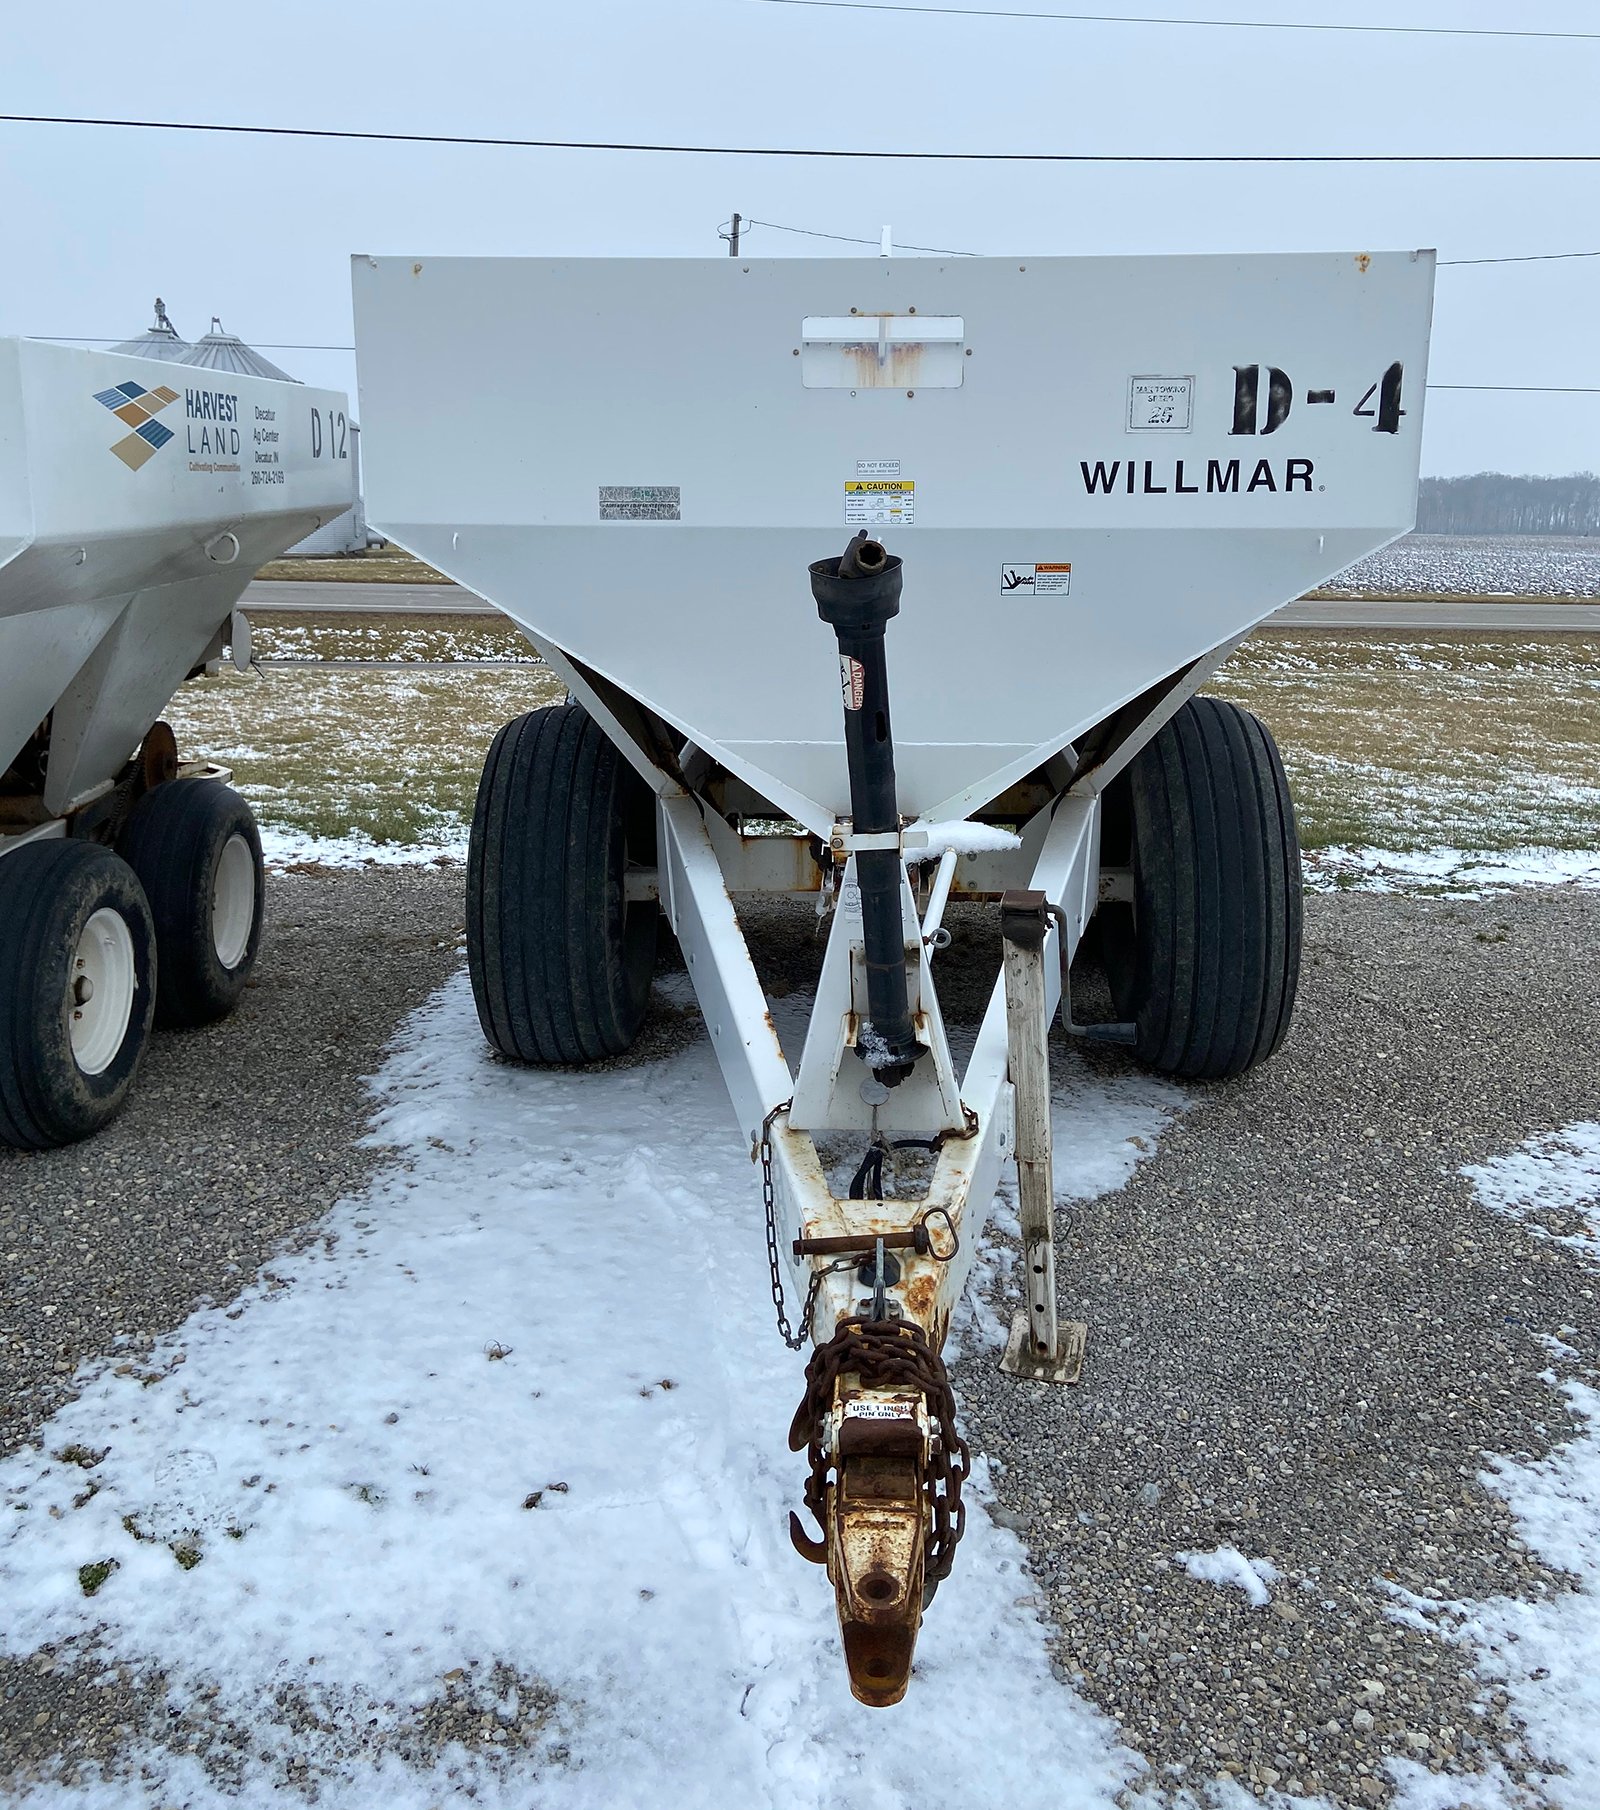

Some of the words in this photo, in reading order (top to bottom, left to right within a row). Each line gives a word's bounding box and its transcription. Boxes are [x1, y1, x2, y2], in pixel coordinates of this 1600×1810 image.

[186, 388, 237, 422] HARVEST
[255, 405, 275, 421] Decatur
[187, 424, 240, 455] LAND
[253, 428, 261, 445] Ag
[262, 428, 279, 443] Center
[273, 451, 279, 463] IN
[866, 482, 903, 490] CAUTION
[853, 672, 864, 707] DANGER
